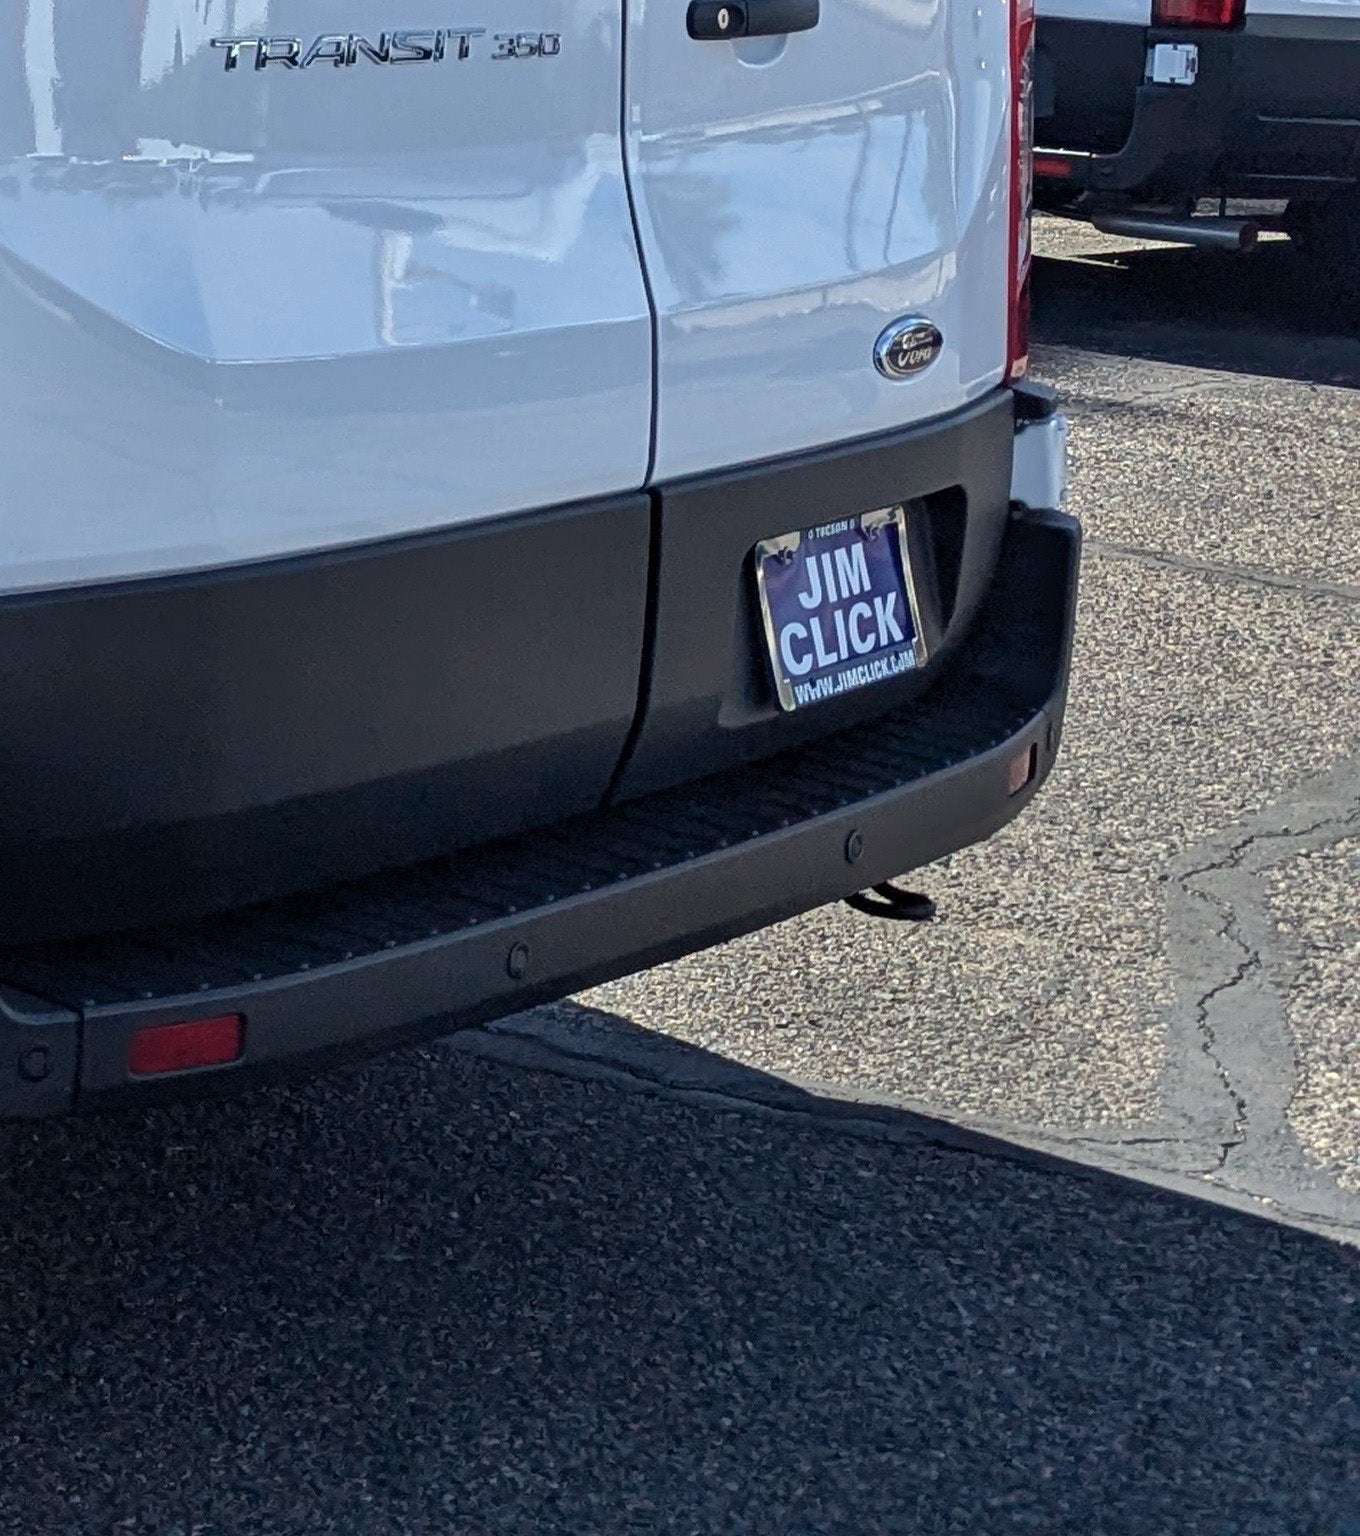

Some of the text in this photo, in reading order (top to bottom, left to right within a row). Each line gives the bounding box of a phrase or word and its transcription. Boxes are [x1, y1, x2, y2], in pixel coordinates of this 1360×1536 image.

[211, 27, 561, 71] TRANSIT 350
[797, 542, 872, 609] JIM
[780, 591, 904, 676] CLICK
[794, 649, 916, 704] WWW.JIMCLICK.COM
